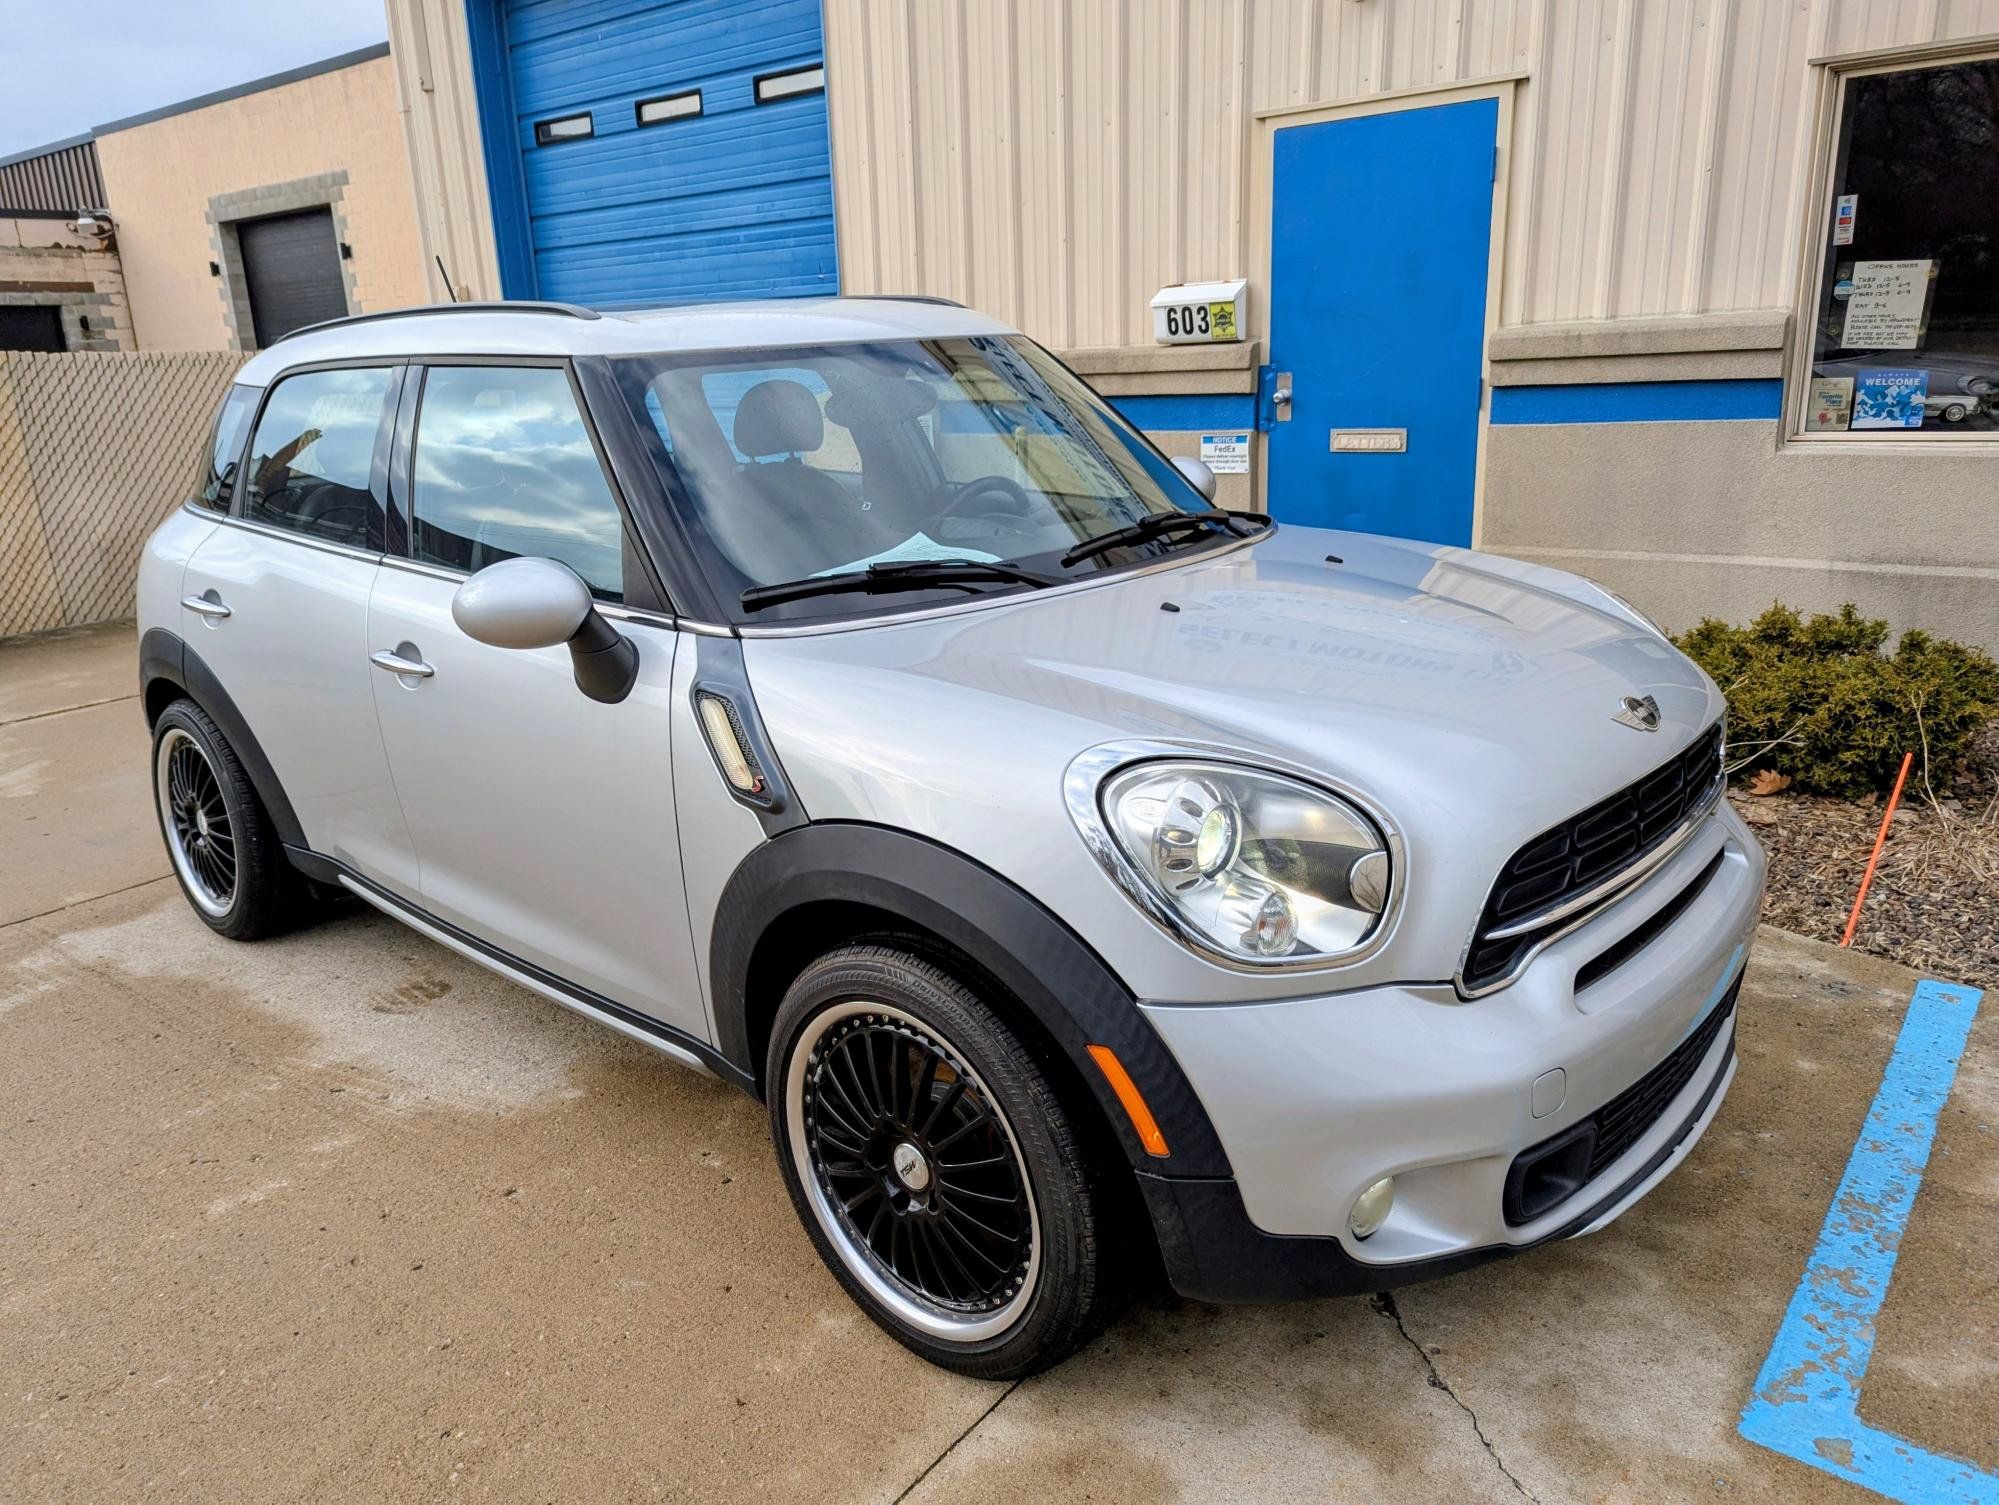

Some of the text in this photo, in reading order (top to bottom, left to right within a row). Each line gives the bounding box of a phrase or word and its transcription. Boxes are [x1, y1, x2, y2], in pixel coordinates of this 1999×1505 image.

[1166, 305, 1210, 336] 603
[1865, 378, 1921, 386] WELCOME
[751, 775, 764, 793] S
[899, 1158, 917, 1178] TSW
